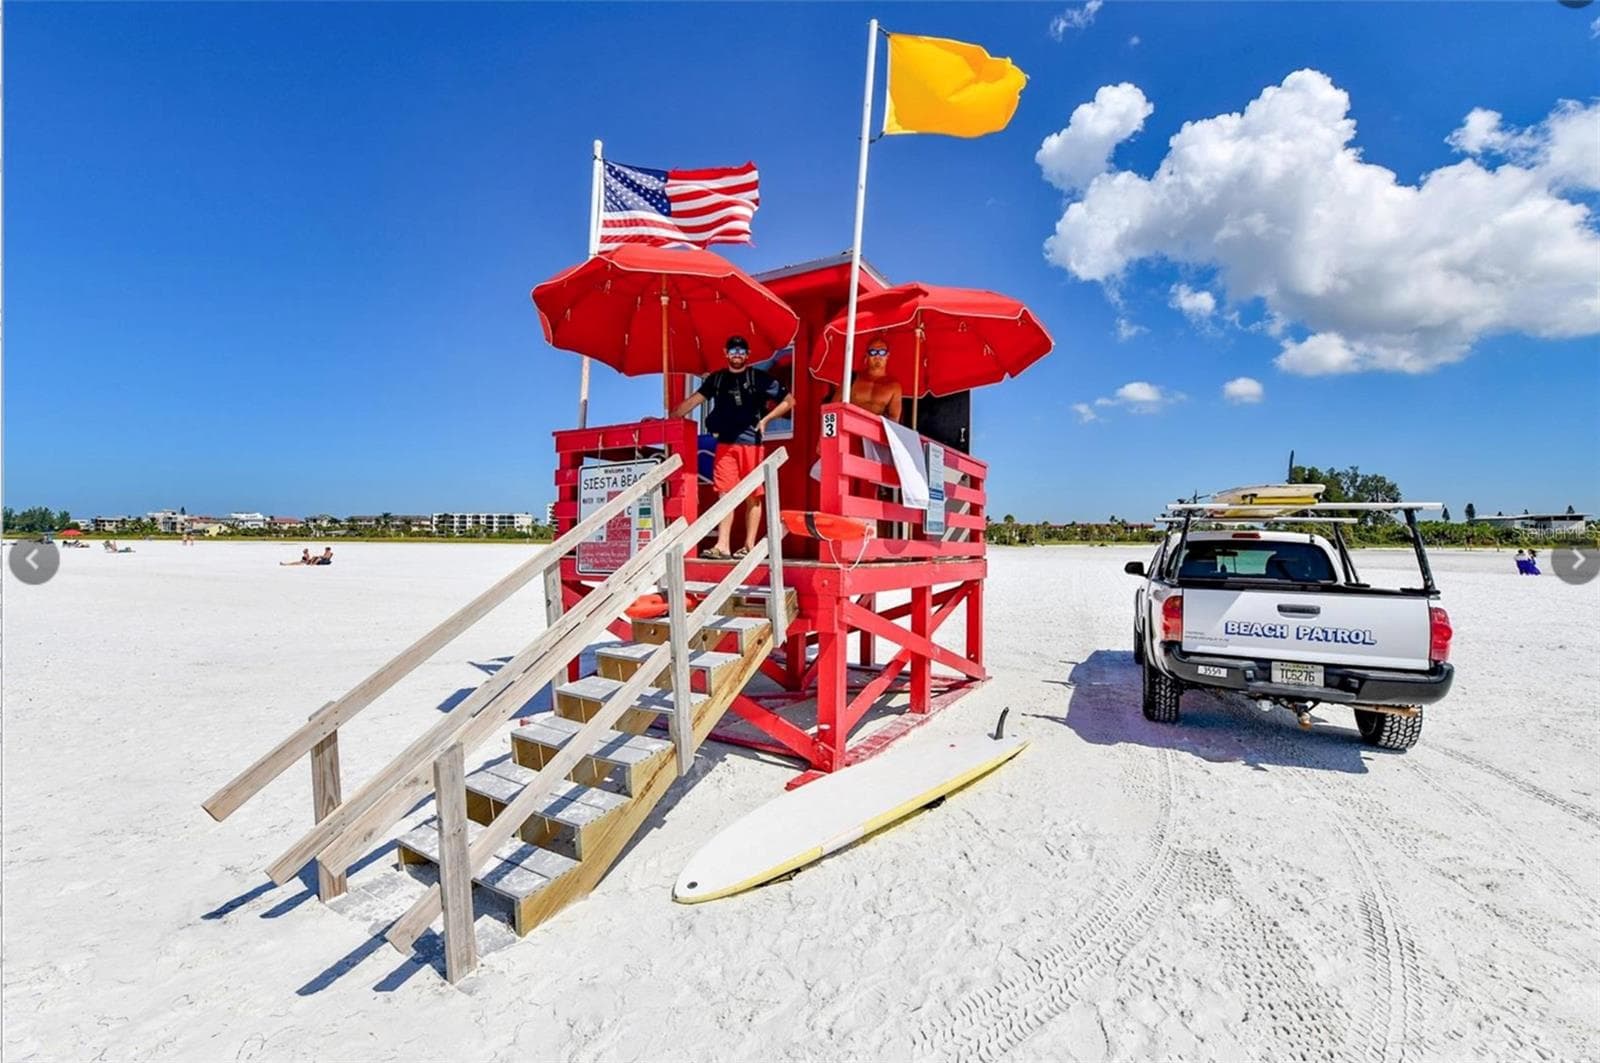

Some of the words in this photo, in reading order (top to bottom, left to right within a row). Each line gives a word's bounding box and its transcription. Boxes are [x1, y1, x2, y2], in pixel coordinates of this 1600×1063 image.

[825, 414, 835, 423] SB
[826, 423, 834, 437] 3
[583, 476, 618, 490] SIESTA
[621, 473, 646, 487] BEAC
[1225, 620, 1289, 639] BEACH
[1296, 625, 1377, 646] PATROL
